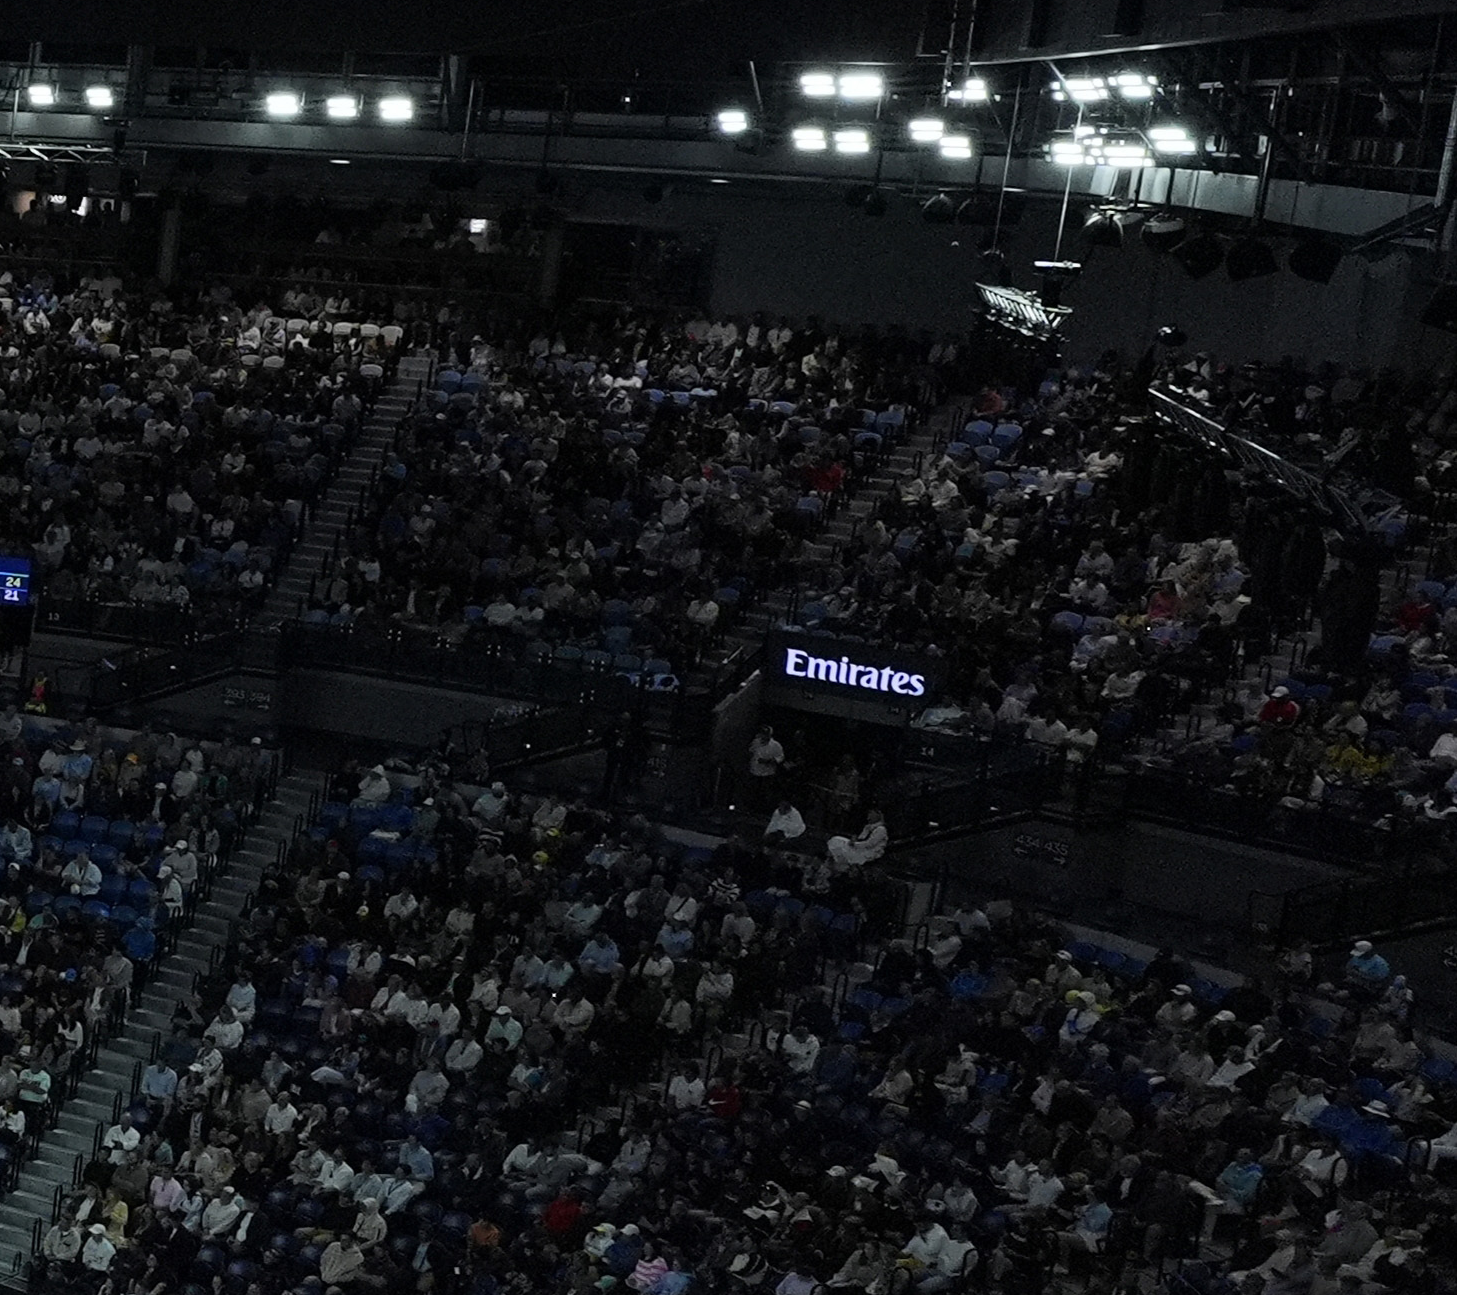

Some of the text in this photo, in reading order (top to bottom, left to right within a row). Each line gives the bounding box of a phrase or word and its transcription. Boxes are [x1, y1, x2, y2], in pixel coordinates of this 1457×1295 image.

[6, 577, 21, 587] 24
[4, 590, 19, 601] 21
[786, 649, 924, 695] Emirates
[1014, 835, 1067, 856] 434 435
